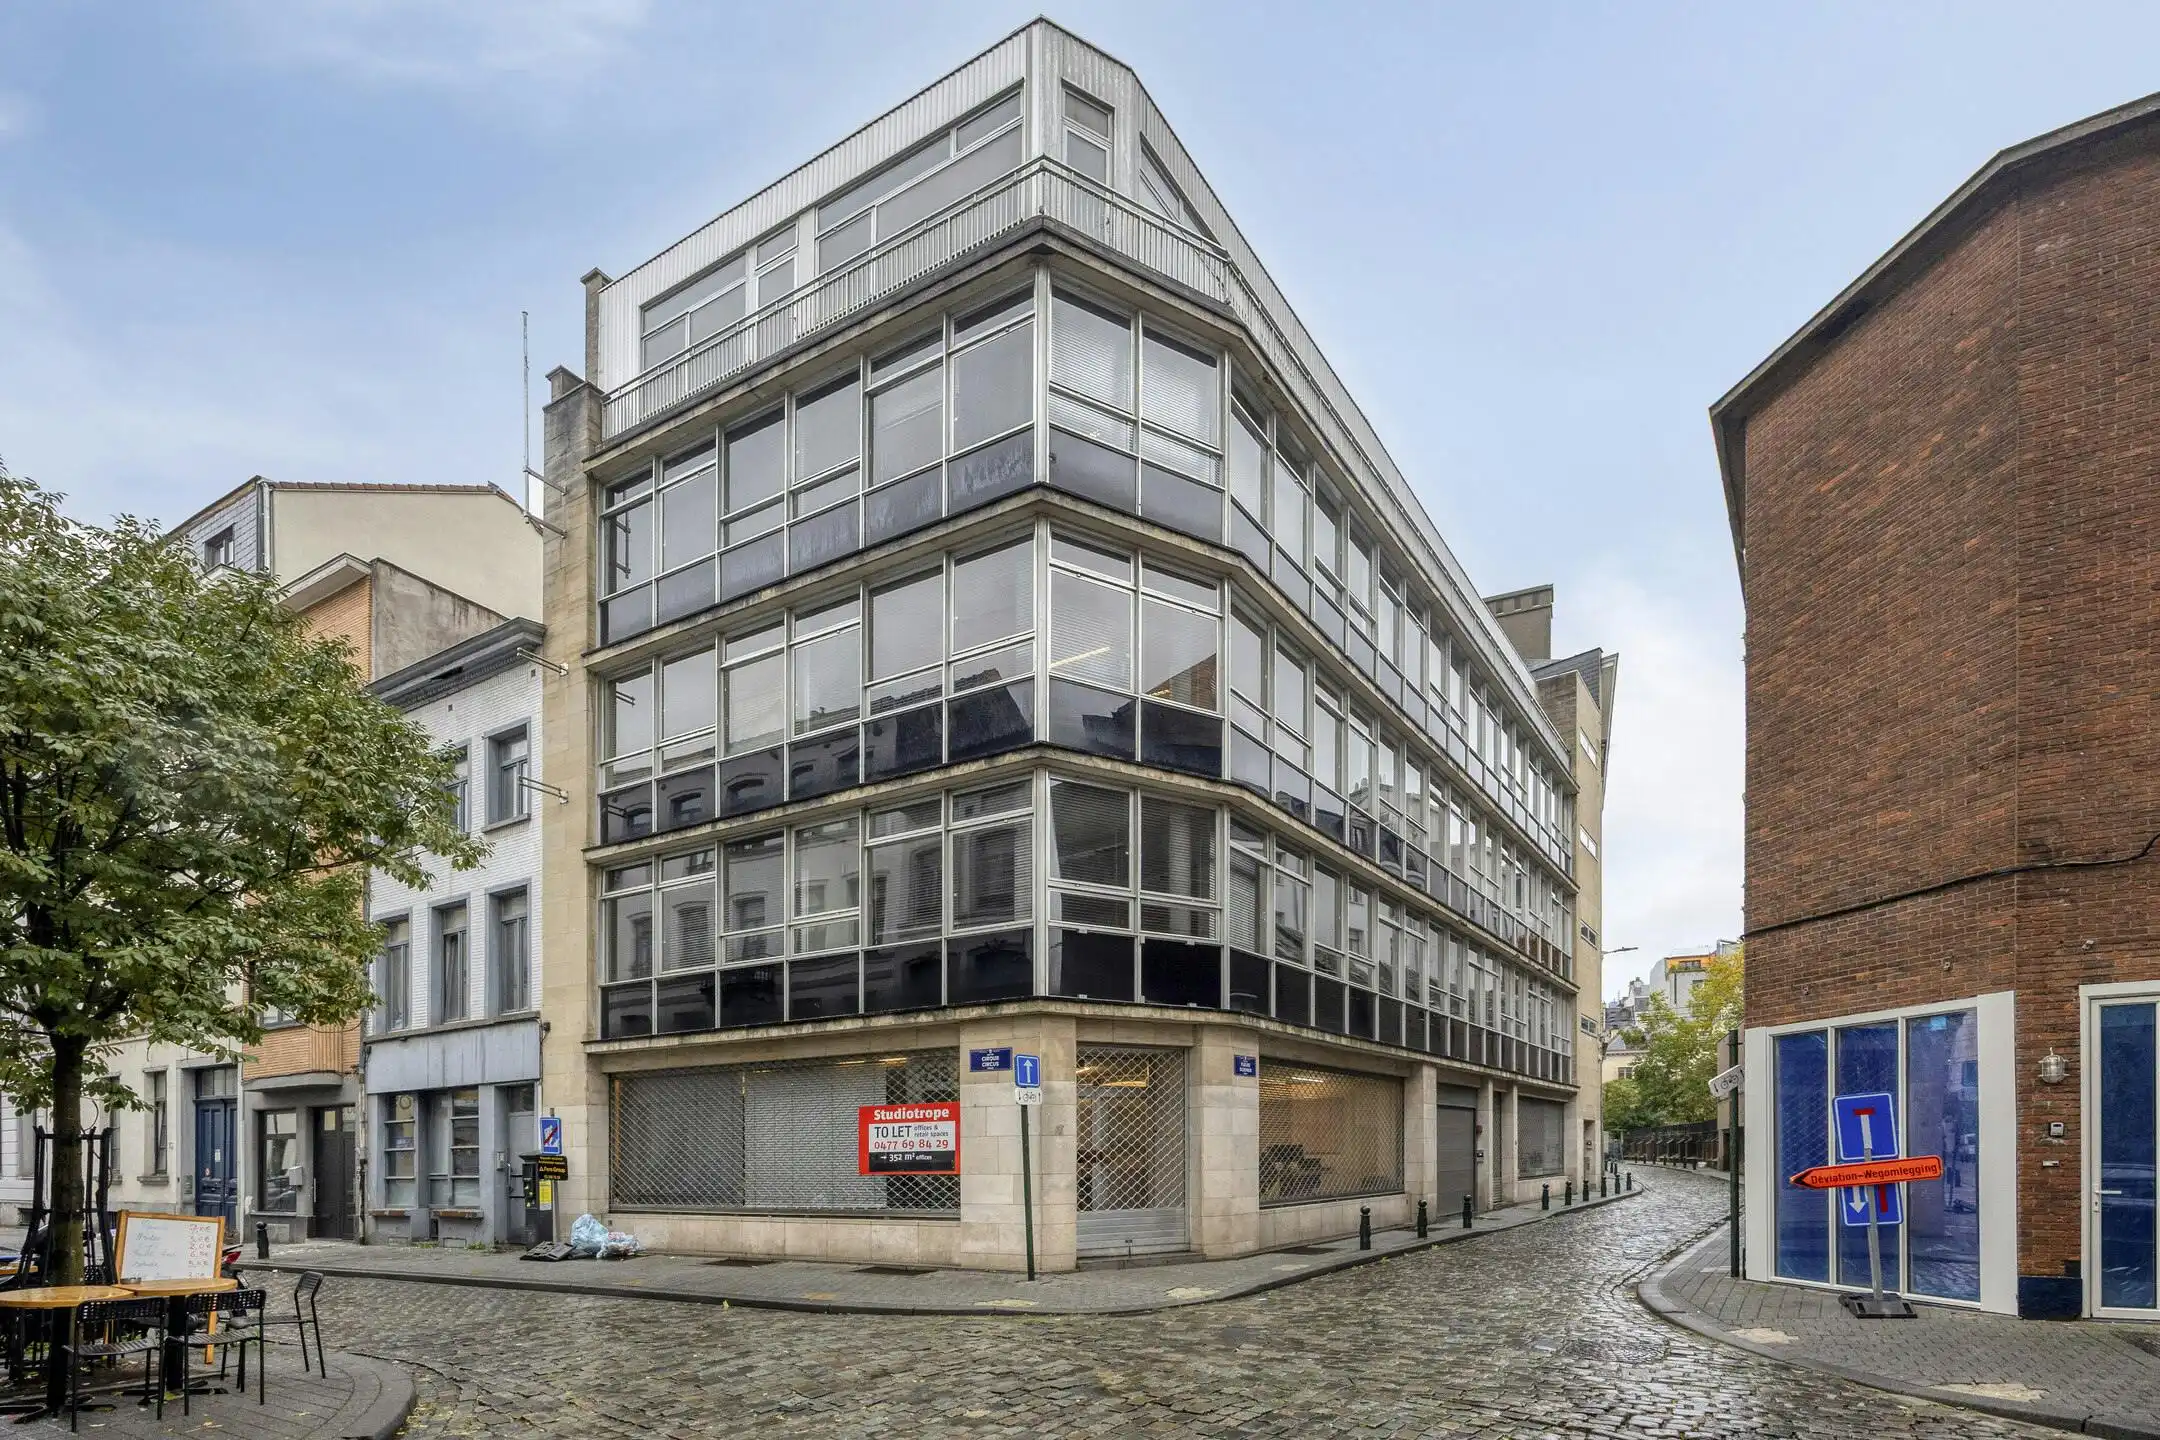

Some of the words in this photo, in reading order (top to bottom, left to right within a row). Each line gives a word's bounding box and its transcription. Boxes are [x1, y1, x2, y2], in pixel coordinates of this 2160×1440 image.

[873, 1107, 950, 1121] Studiotrope
[874, 1126, 889, 1138] TO
[892, 1125, 912, 1138] LET
[874, 1141, 898, 1150] 0477
[902, 1140, 915, 1150] 69
[918, 1139, 932, 1149] 84
[936, 1139, 949, 1148] 29
[889, 1154, 903, 1162] 352
